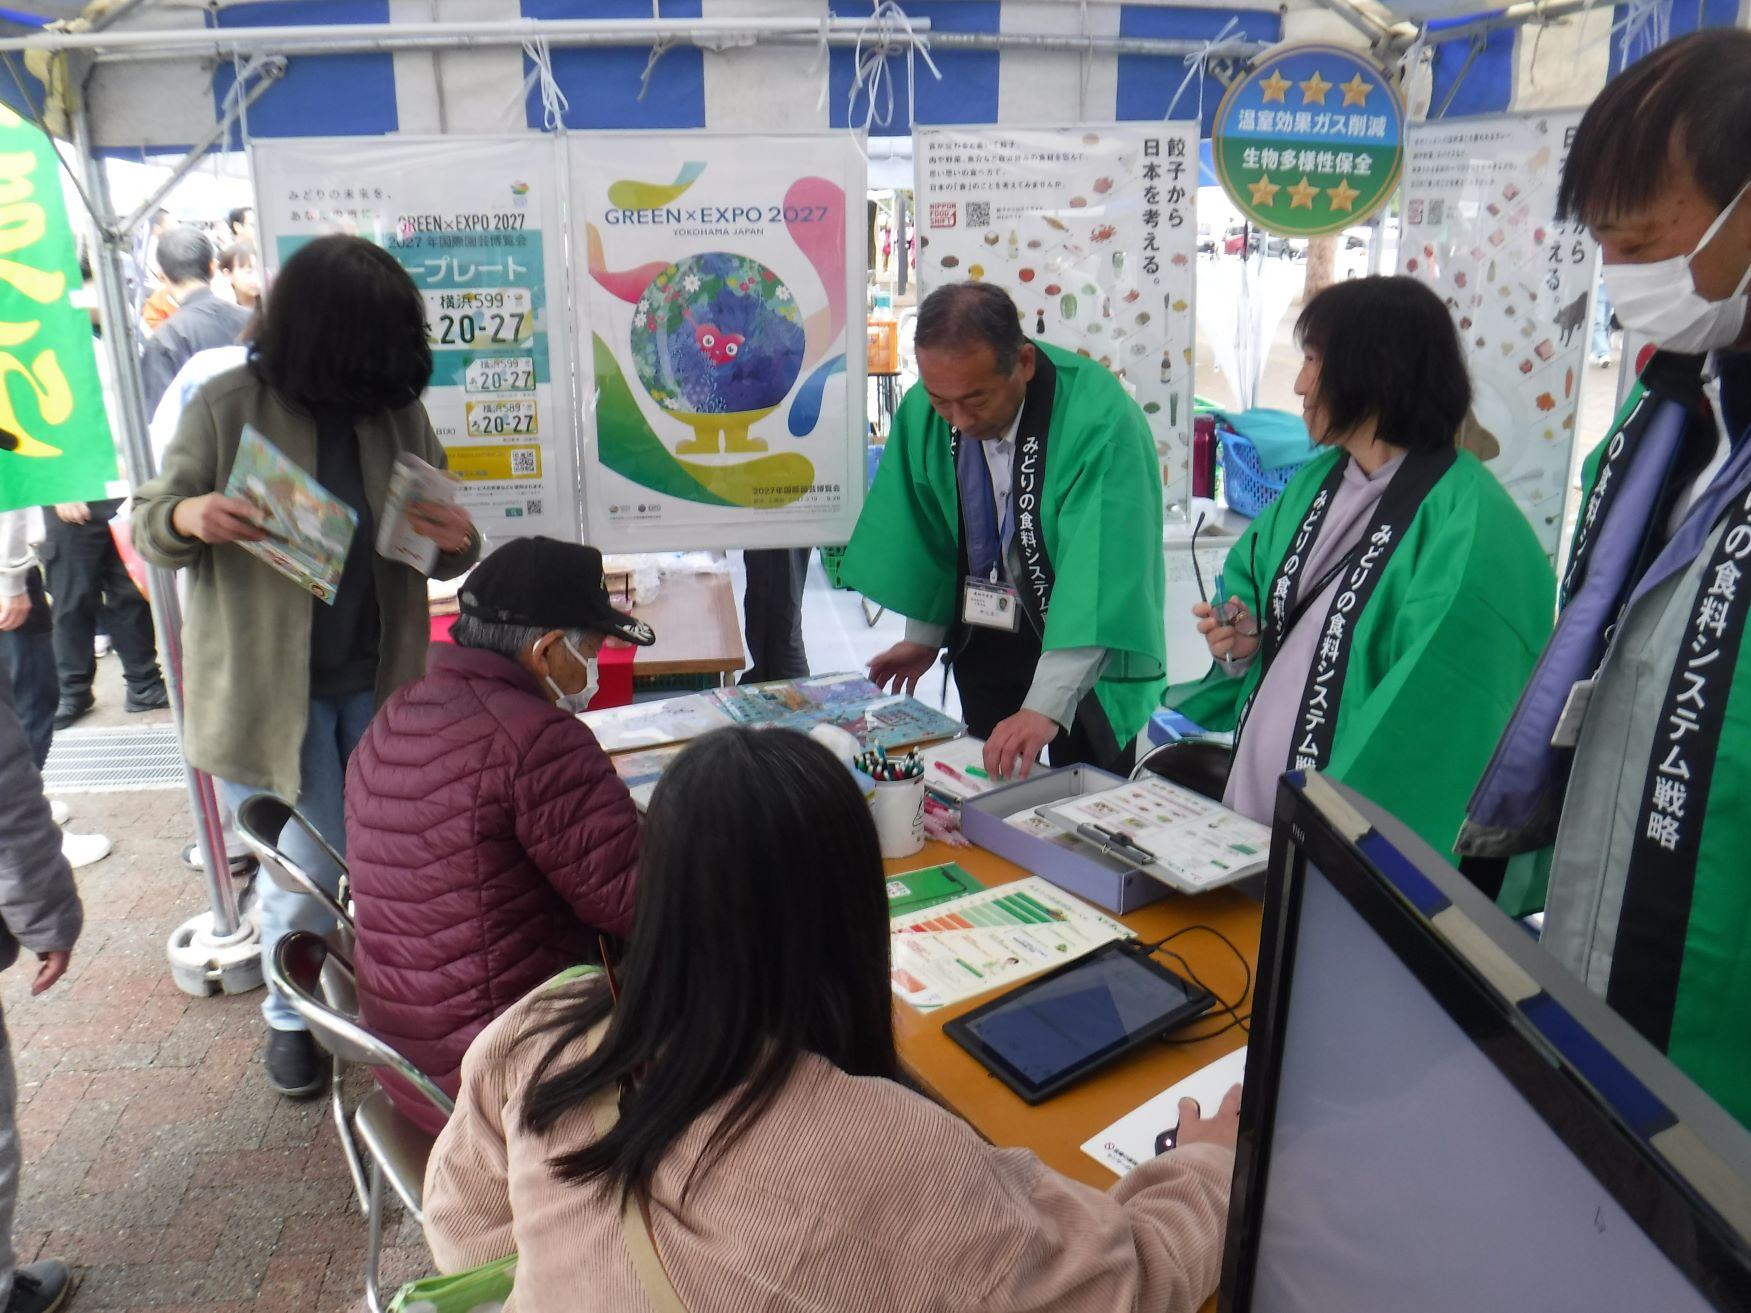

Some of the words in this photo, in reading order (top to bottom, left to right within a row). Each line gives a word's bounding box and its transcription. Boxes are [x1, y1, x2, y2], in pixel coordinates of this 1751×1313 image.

[1238, 108, 1387, 138] 温室効果ガス削減
[1242, 147, 1373, 175] 生物多様性保全
[1167, 137, 1186, 227] 餃子から
[494, 213, 525, 230] 2027
[768, 206, 829, 223] 2027
[1142, 138, 1161, 285] 日本を考える。
[673, 227, 730, 236] YOKOHAMA
[733, 227, 765, 236] JAPAN
[397, 255, 527, 282] ープレート
[440, 312, 525, 344] 20-27
[480, 370, 531, 390] 20-27
[483, 414, 534, 434] 20-27
